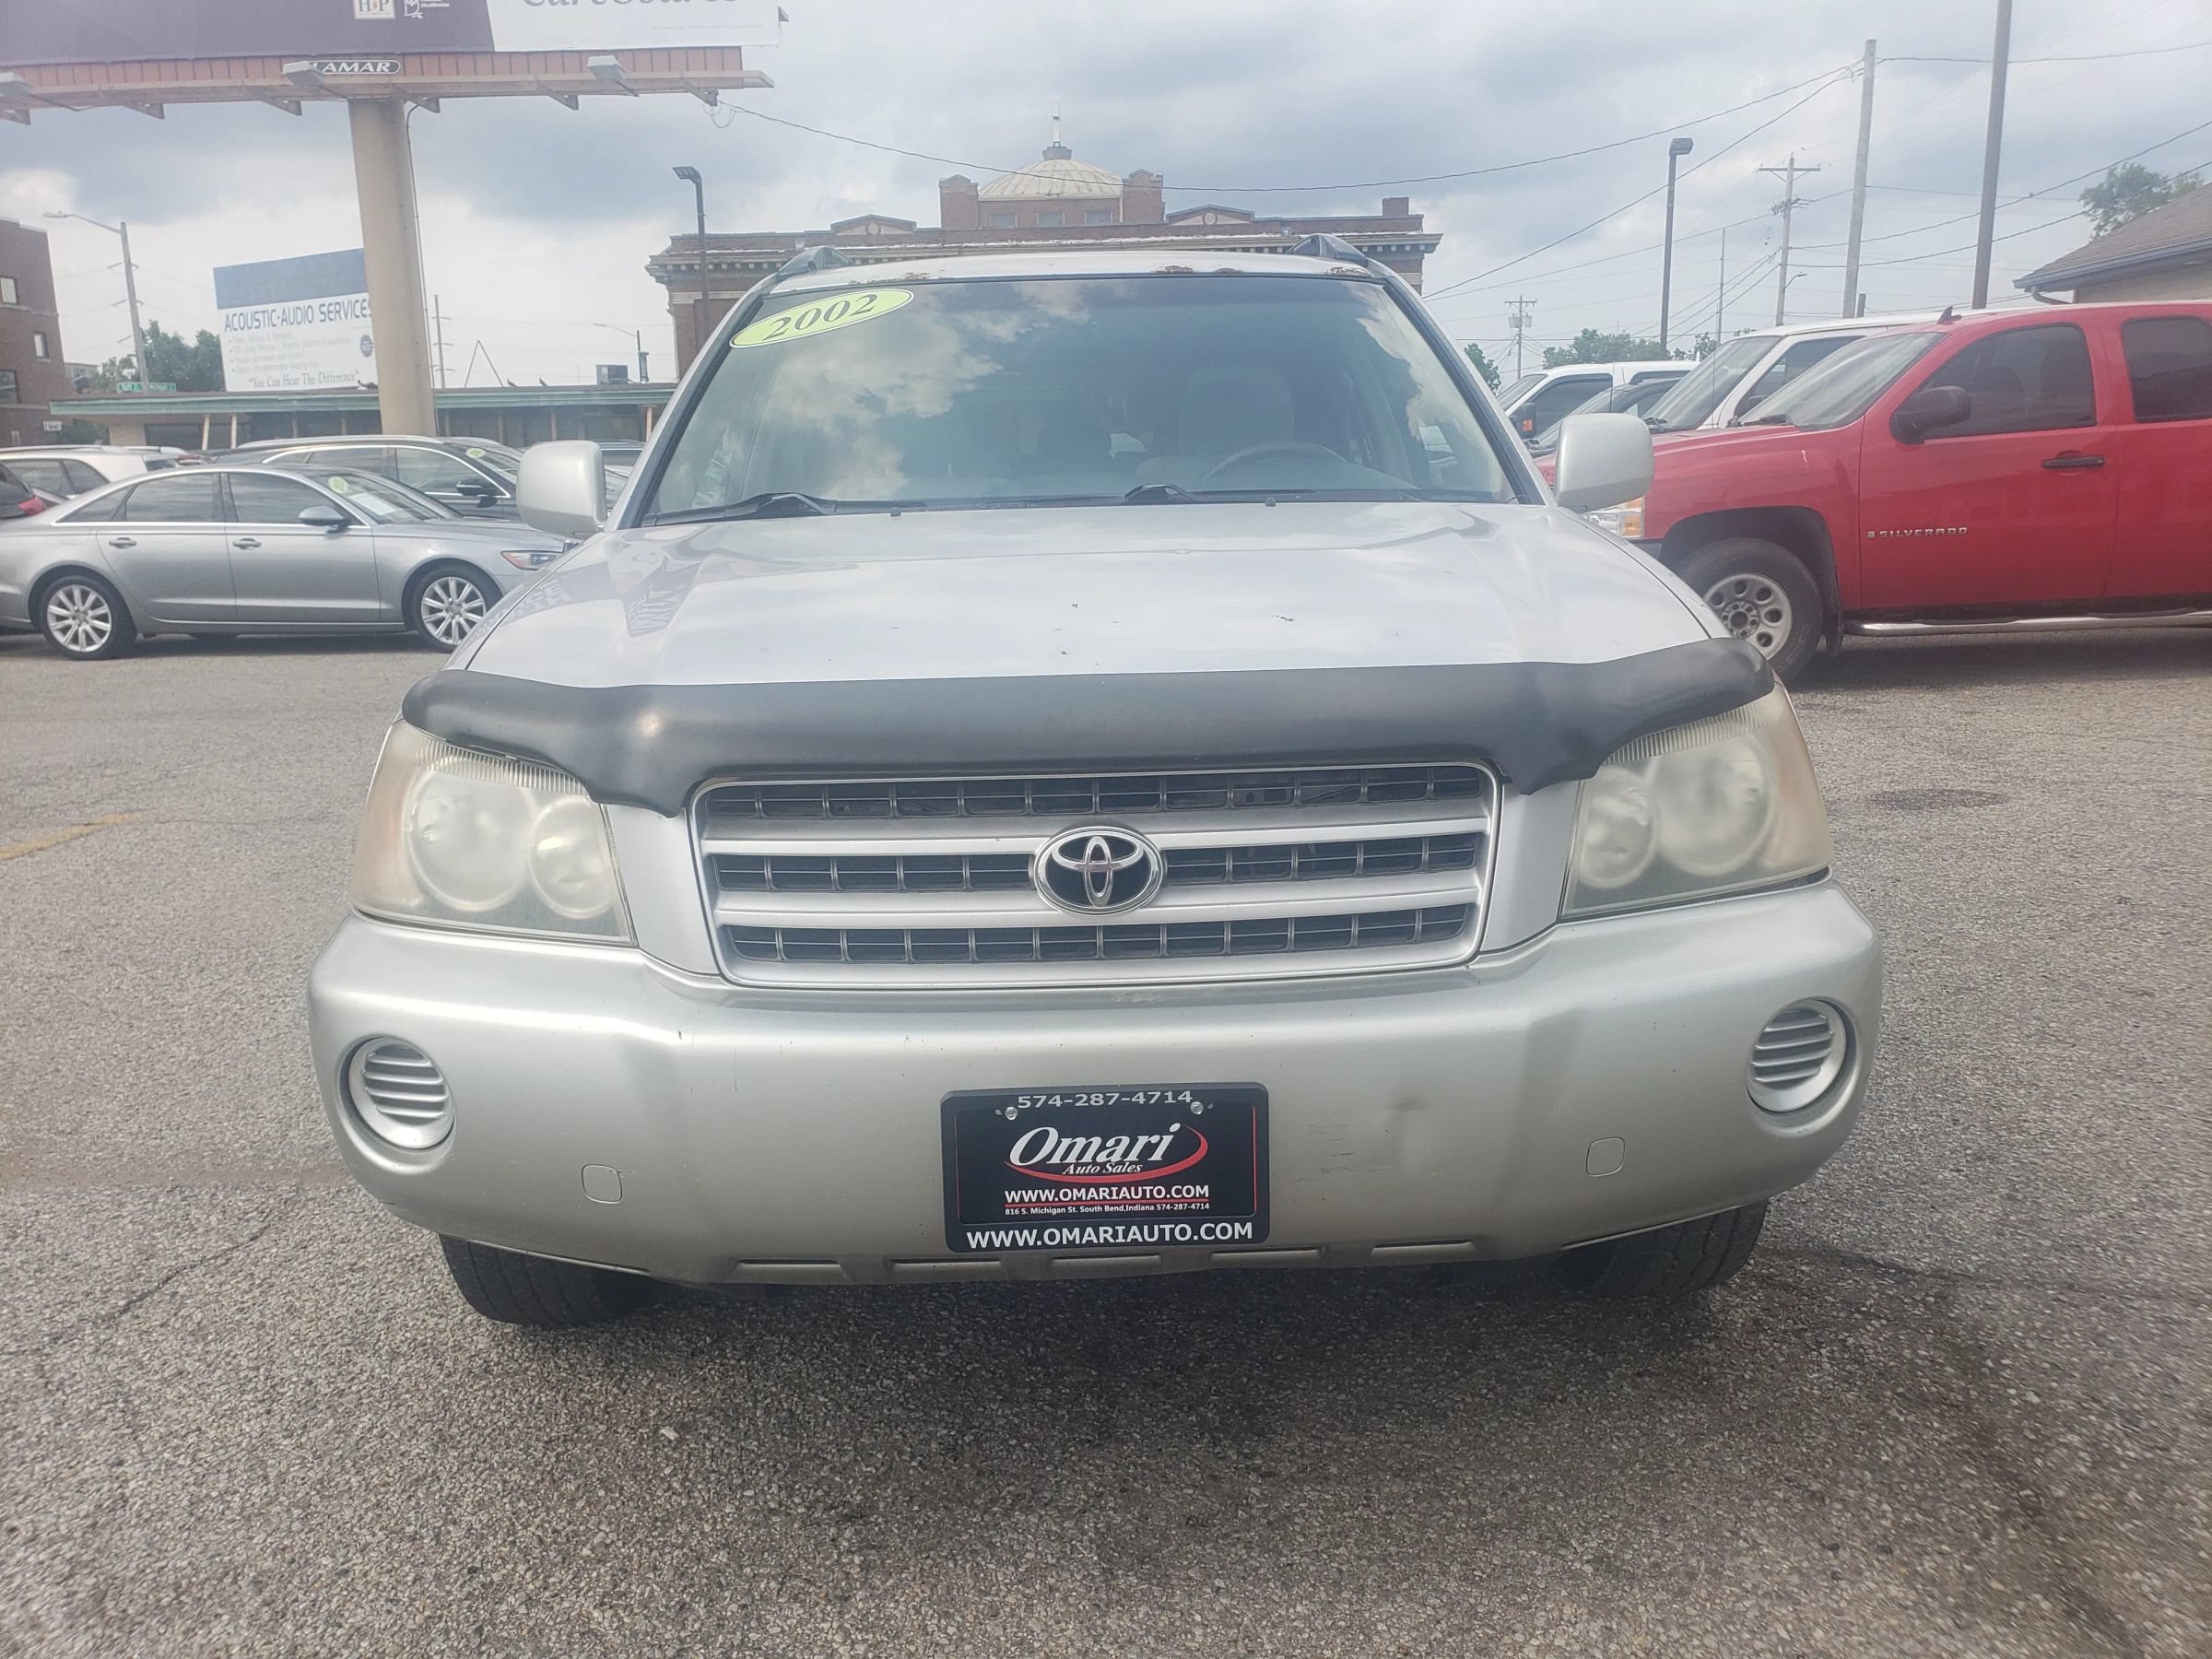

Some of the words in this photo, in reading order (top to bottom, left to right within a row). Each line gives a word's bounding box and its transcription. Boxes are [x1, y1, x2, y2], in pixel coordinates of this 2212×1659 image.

[762, 293, 877, 342] 2002
[266, 375, 281, 388] Can
[283, 374, 300, 387] Hear
[302, 372, 316, 385] The
[1879, 527, 1968, 538] SILVERADO
[1018, 1090, 1194, 1110] 574-287-4714
[1009, 1123, 1182, 1167] Omari
[1062, 1163, 1100, 1175] Auto
[1102, 1161, 1143, 1174] Sales
[1005, 1184, 1209, 1204] WWW.OMARIAUTO.COM
[1030, 1206, 1066, 1216] Michigan
[1067, 1206, 1078, 1214] St.
[1079, 1205, 1103, 1213] South
[1156, 1202, 1210, 1211] 574-287-4714
[966, 1221, 1253, 1249] WWW.OMARIAUTO.COM
